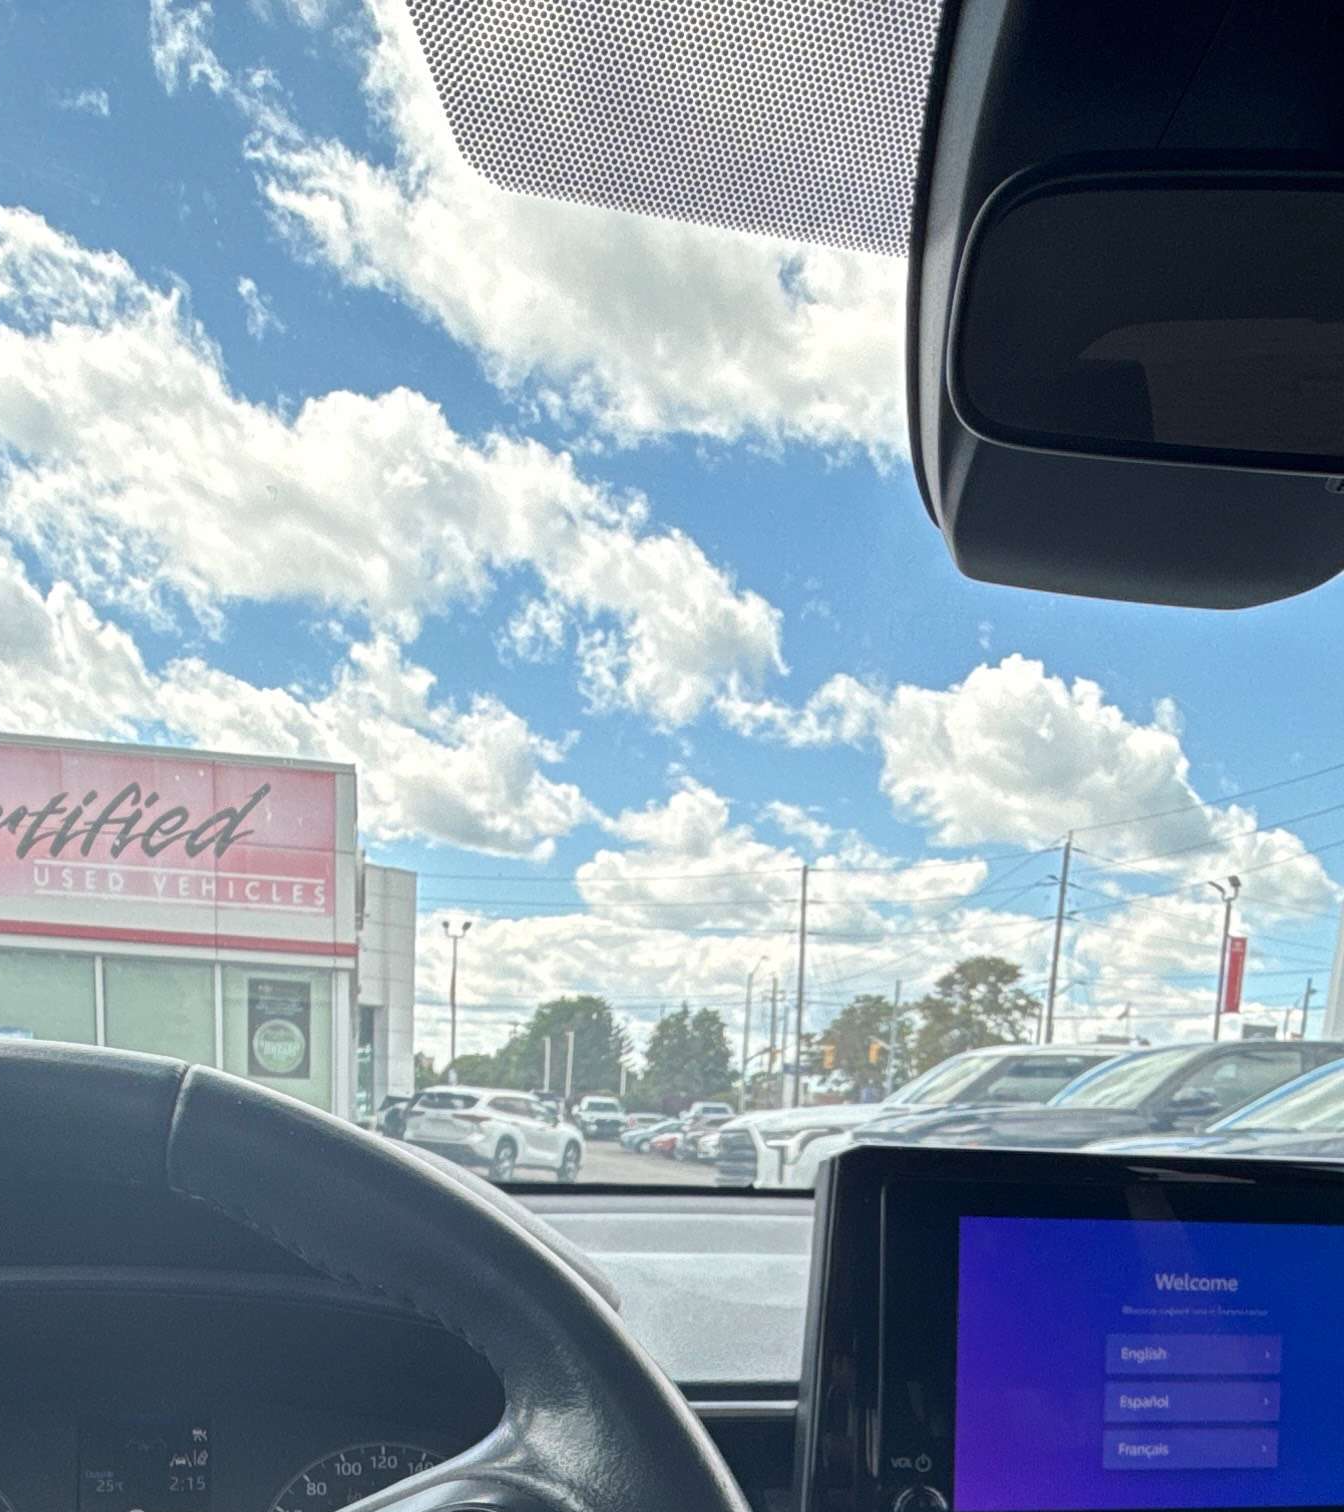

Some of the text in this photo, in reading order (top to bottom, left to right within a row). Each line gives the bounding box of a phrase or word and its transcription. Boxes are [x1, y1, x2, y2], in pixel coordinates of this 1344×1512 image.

[33, 865, 327, 908] USED VEHICLES
[1154, 1272, 1239, 1292] Welcome
[1120, 1346, 1168, 1364] English
[1119, 1394, 1170, 1411] Español
[1117, 1442, 1170, 1460] Français
[334, 1461, 363, 1477] 100
[369, 1455, 398, 1470] 120
[168, 1475, 207, 1492] 2:15
[306, 1481, 328, 1496] 80
